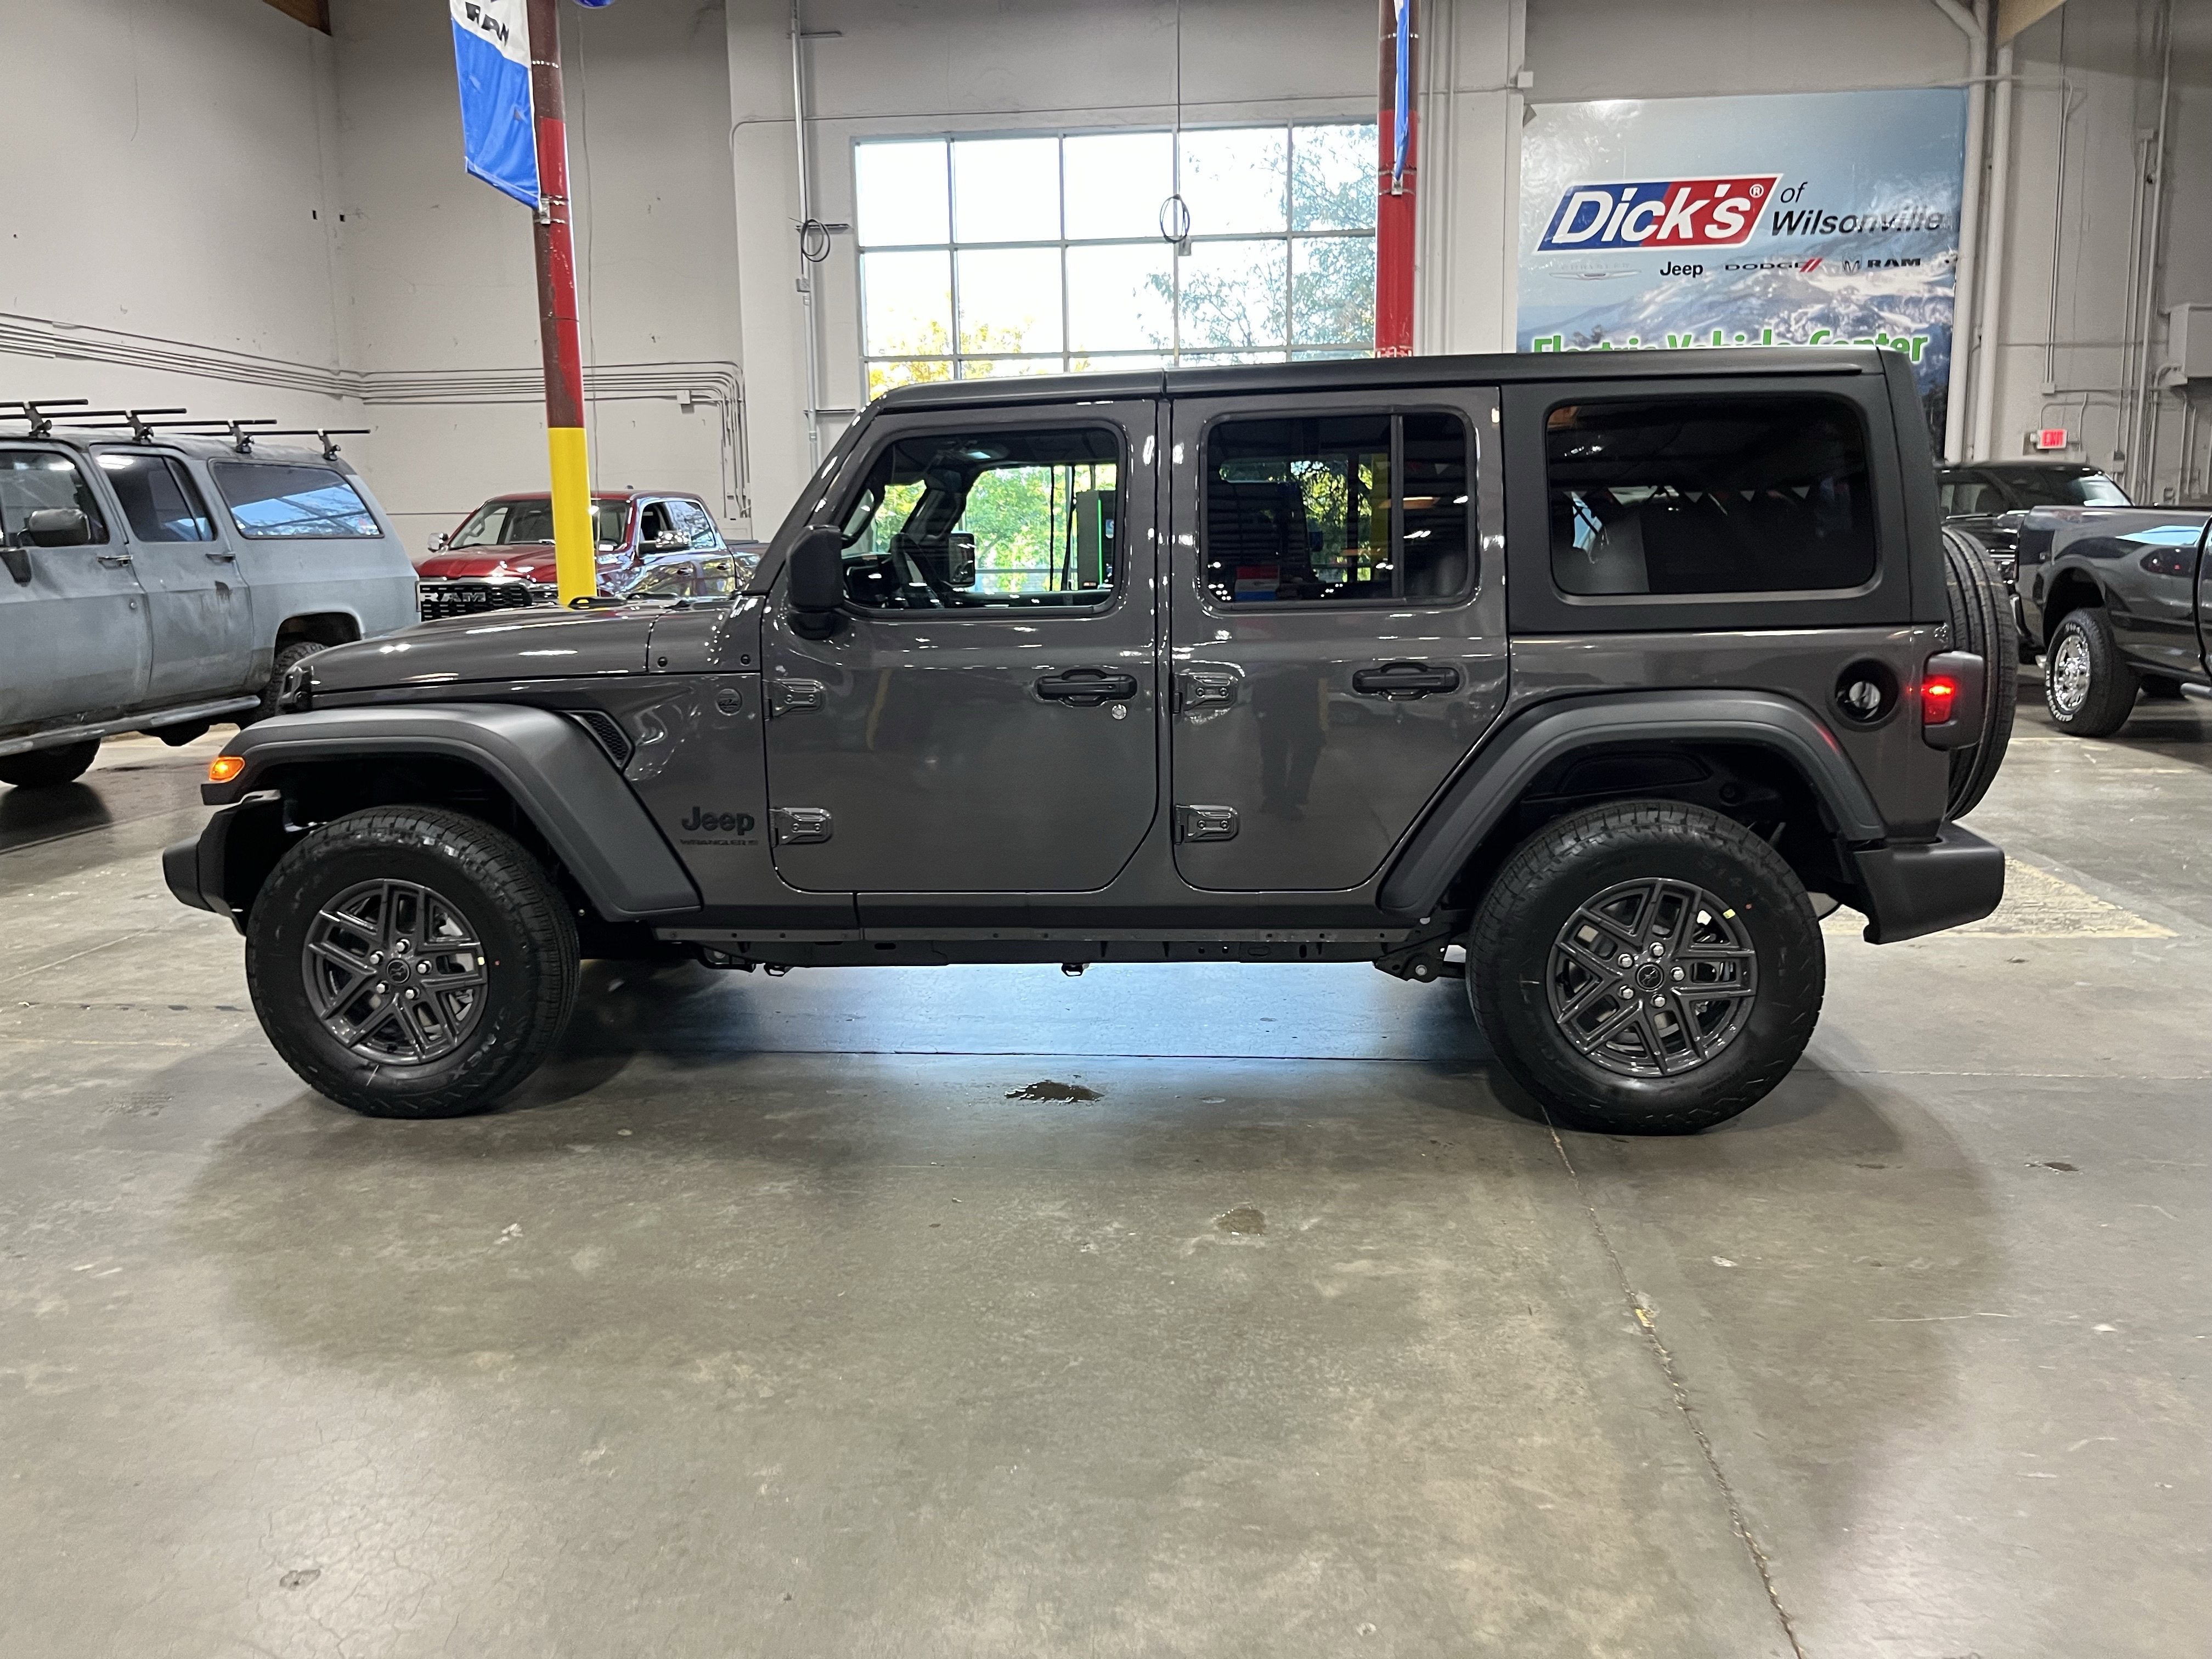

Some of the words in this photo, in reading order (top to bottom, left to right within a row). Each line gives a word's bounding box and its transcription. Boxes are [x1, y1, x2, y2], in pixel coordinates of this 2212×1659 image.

[1780, 181, 1808, 204] of
[1551, 184, 1751, 244] Dick's
[1660, 261, 1703, 278] Jeep
[1867, 258, 1921, 267] RAM
[2043, 431, 2064, 446] EXIT
[420, 592, 486, 602] RAM
[682, 806, 755, 836] Jeep
